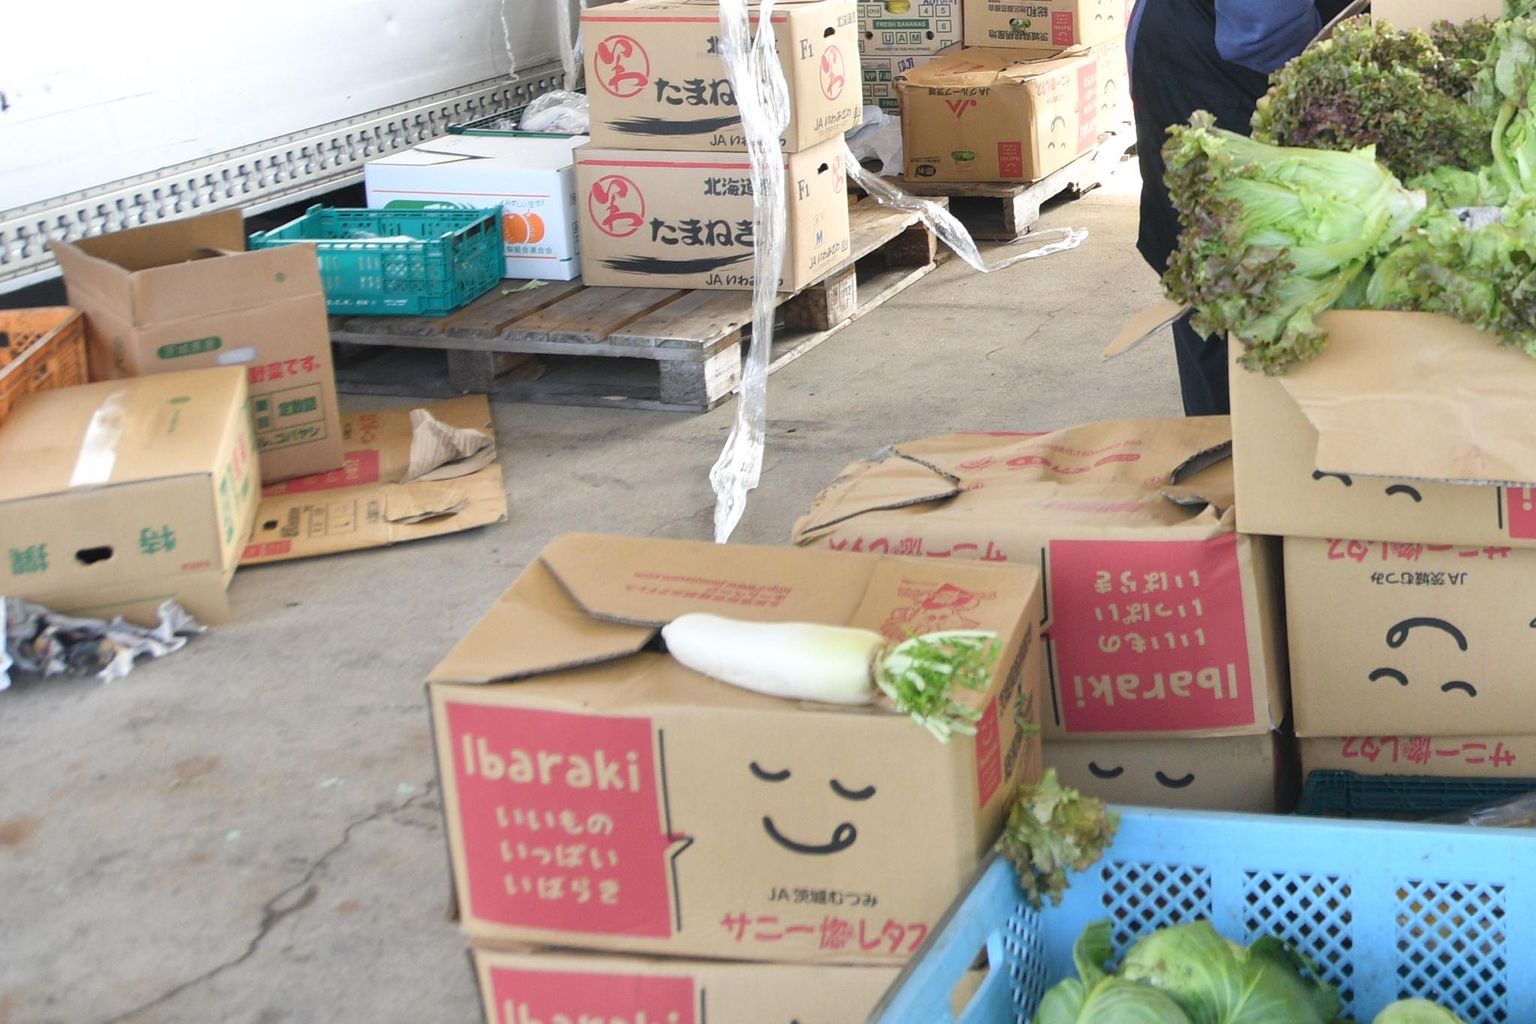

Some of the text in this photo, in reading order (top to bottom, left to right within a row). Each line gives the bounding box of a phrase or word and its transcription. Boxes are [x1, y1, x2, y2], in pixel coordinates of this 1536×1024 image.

[800, 38, 814, 60] F1
[885, 34, 919, 42] U A M
[865, 72, 875, 80] VP
[654, 77, 741, 106] たまね
[928, 86, 991, 96] JA グループ茨城
[710, 135, 727, 147] JA
[798, 179, 810, 201] F1
[650, 217, 762, 247] たまねぎ
[706, 273, 723, 286] JA
[140, 525, 176, 555] 特
[1093, 569, 1201, 594] いばらき
[1371, 571, 1468, 587] JA 茨城むつみ
[1094, 599, 1206, 625] いっぱい
[1098, 628, 1208, 654] いいもの
[1073, 663, 1238, 708] Ibaraki
[461, 733, 641, 794] Ibaraki
[493, 806, 615, 835] いいもの
[499, 839, 620, 869] いっぱい
[503, 877, 622, 905] いばらき
[767, 888, 878, 909] JA 茨城むつみ
